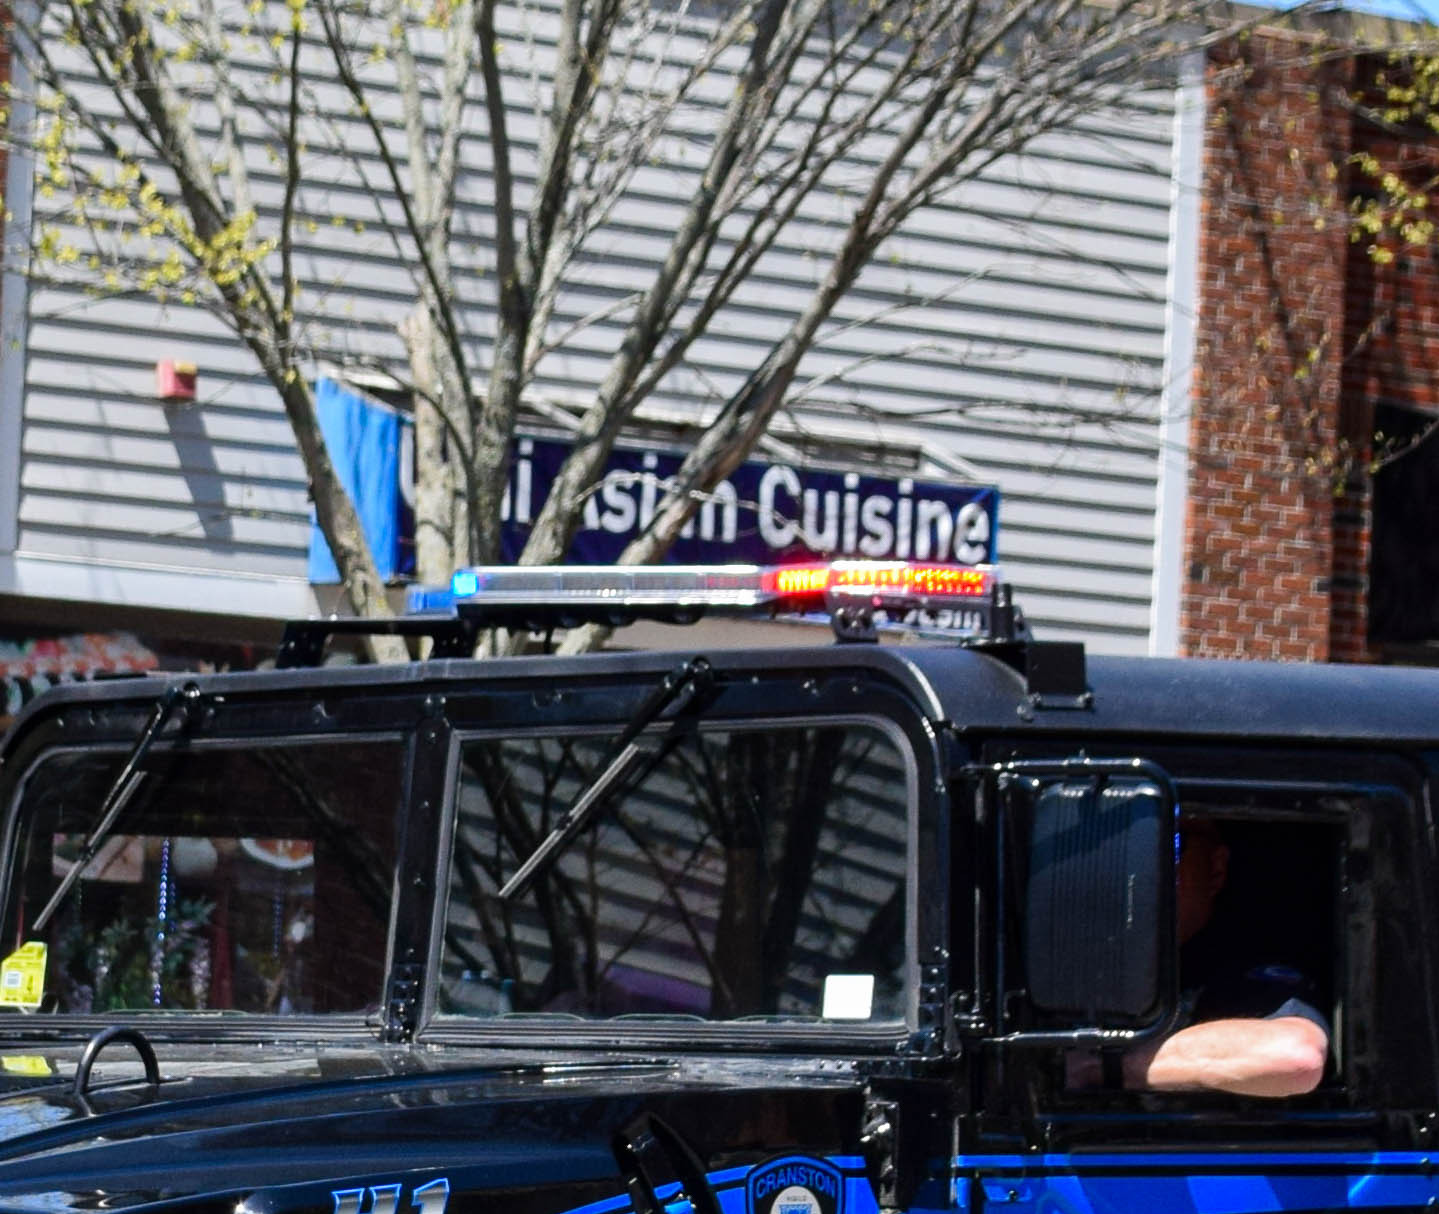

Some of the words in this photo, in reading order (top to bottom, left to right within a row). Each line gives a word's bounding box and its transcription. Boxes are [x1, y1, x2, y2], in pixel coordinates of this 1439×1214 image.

[568, 452, 738, 544] sin
[757, 465, 990, 565] Cuisine
[756, 1165, 837, 1199] CRANSTON
